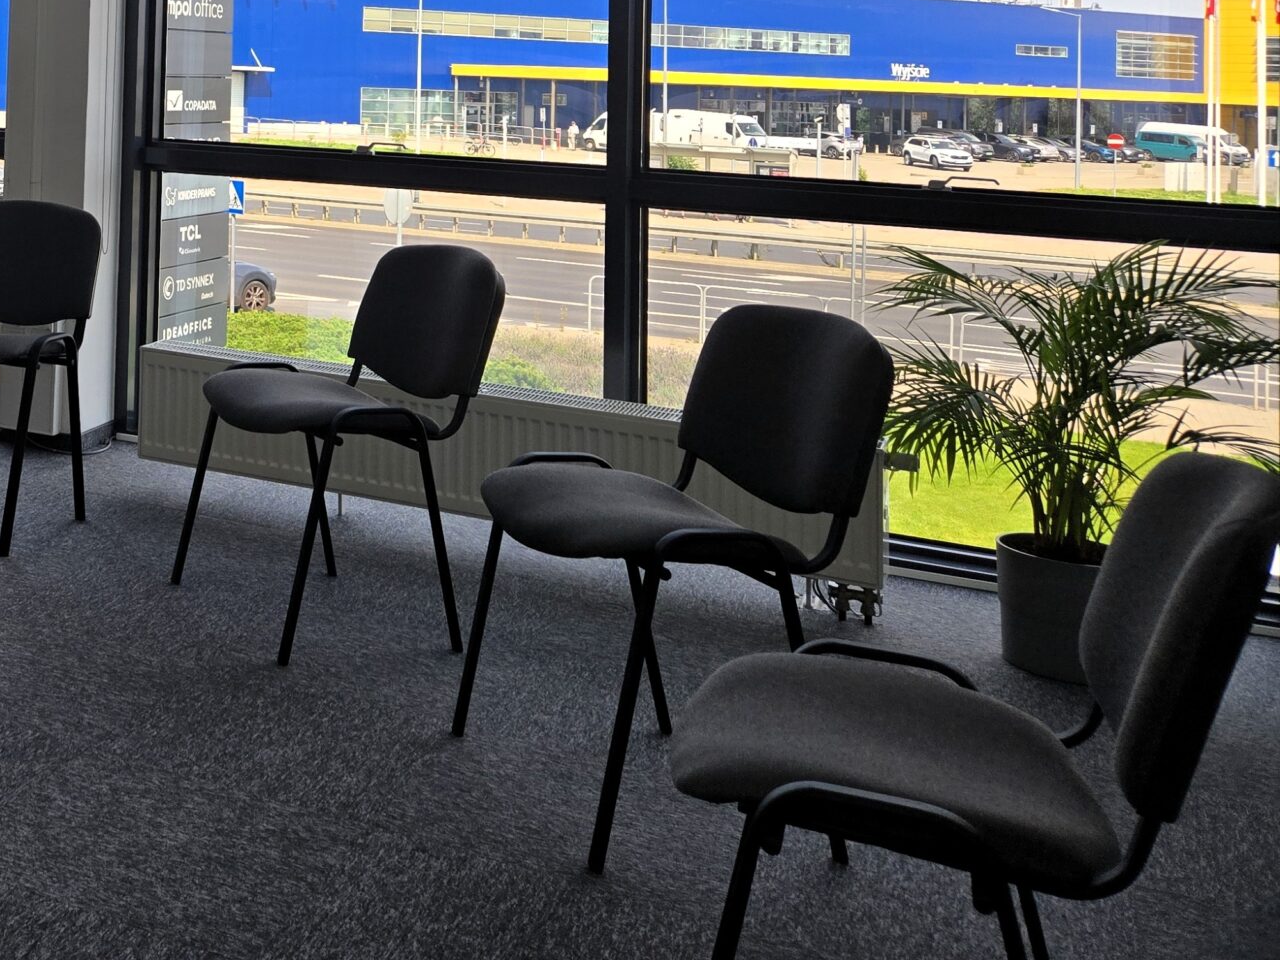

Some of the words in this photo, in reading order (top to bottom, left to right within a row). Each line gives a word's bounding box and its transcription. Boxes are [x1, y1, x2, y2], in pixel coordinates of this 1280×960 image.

[890, 62, 930, 81] Wyjście
[180, 224, 202, 242] TCL
[176, 279, 186, 292] TD
[186, 273, 214, 290] SYNNEX
[162, 317, 213, 341] IDEAOFFICE
